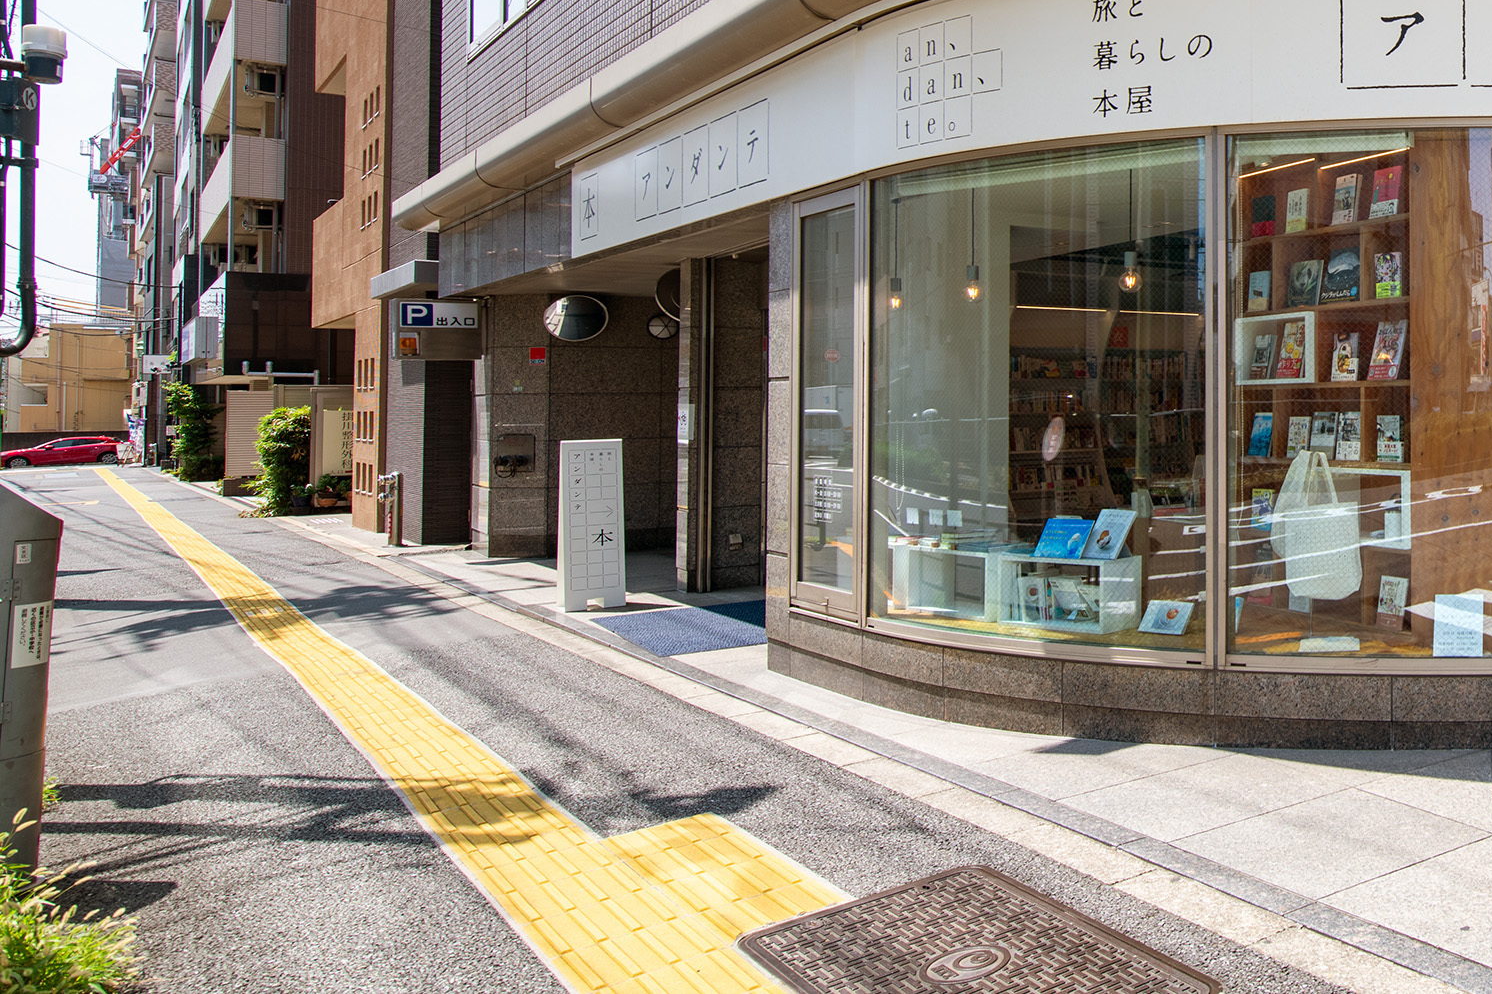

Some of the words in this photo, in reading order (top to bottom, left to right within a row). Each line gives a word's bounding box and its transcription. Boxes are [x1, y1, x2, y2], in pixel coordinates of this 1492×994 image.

[1092, 33, 1213, 71] 暮らしの
[1092, 84, 1153, 118] 本屋
[641, 129, 759, 201] アンダンテ
[582, 187, 596, 229] 本
[406, 304, 428, 325] P
[436, 316, 476, 327] 出入口
[573, 452, 583, 511] アンダンテ
[591, 528, 614, 547] 本
